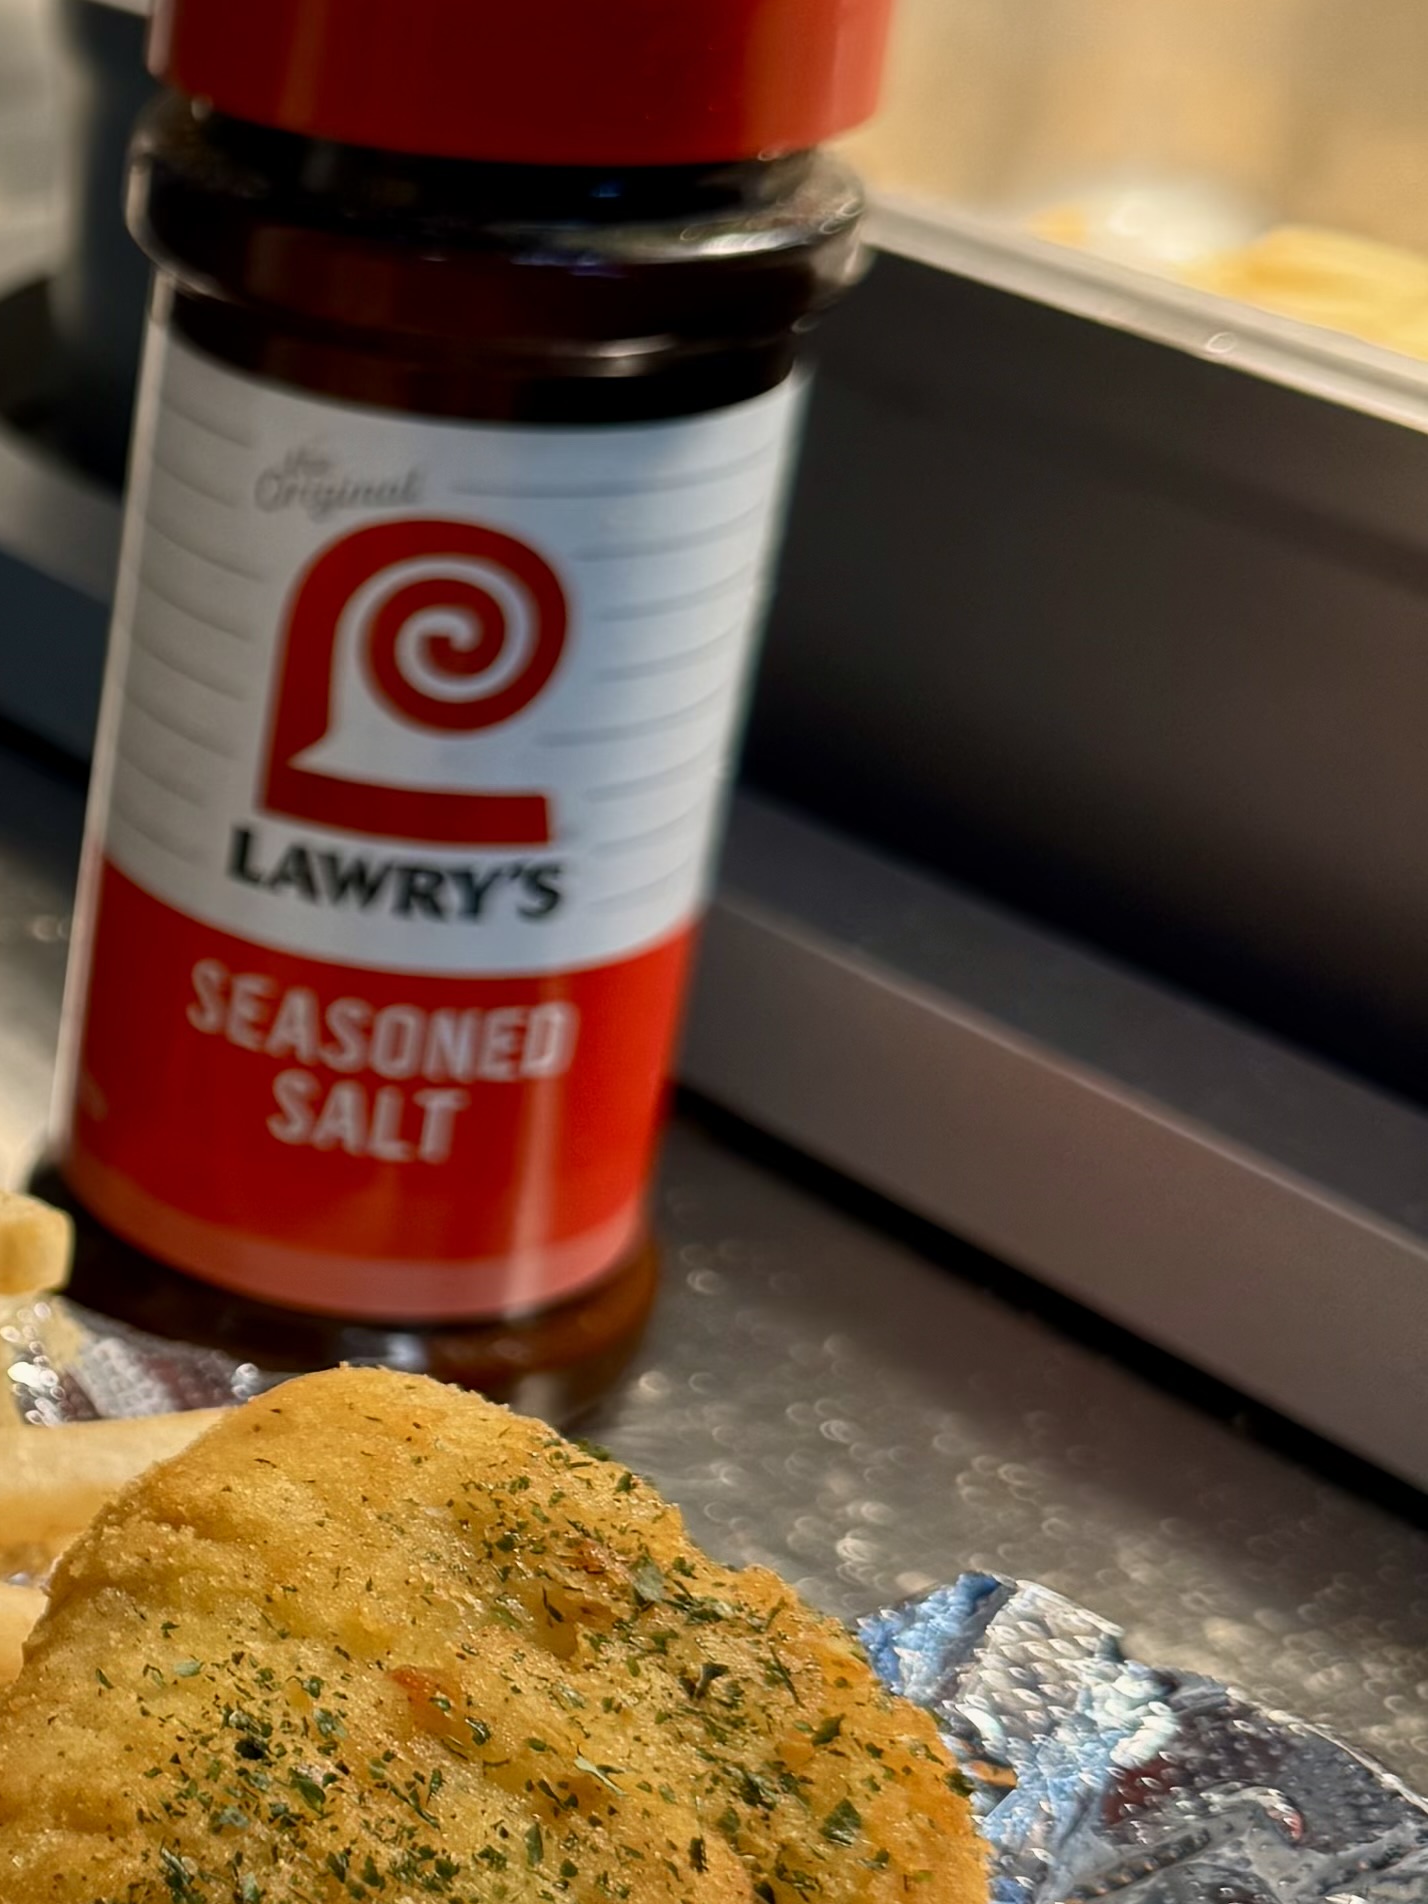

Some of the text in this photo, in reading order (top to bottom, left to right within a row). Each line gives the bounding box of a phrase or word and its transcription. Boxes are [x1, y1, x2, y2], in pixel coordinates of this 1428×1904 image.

[226, 825, 566, 923] LAWRY'S
[186, 957, 581, 1083] SEASONED
[266, 1069, 470, 1165] SALT
